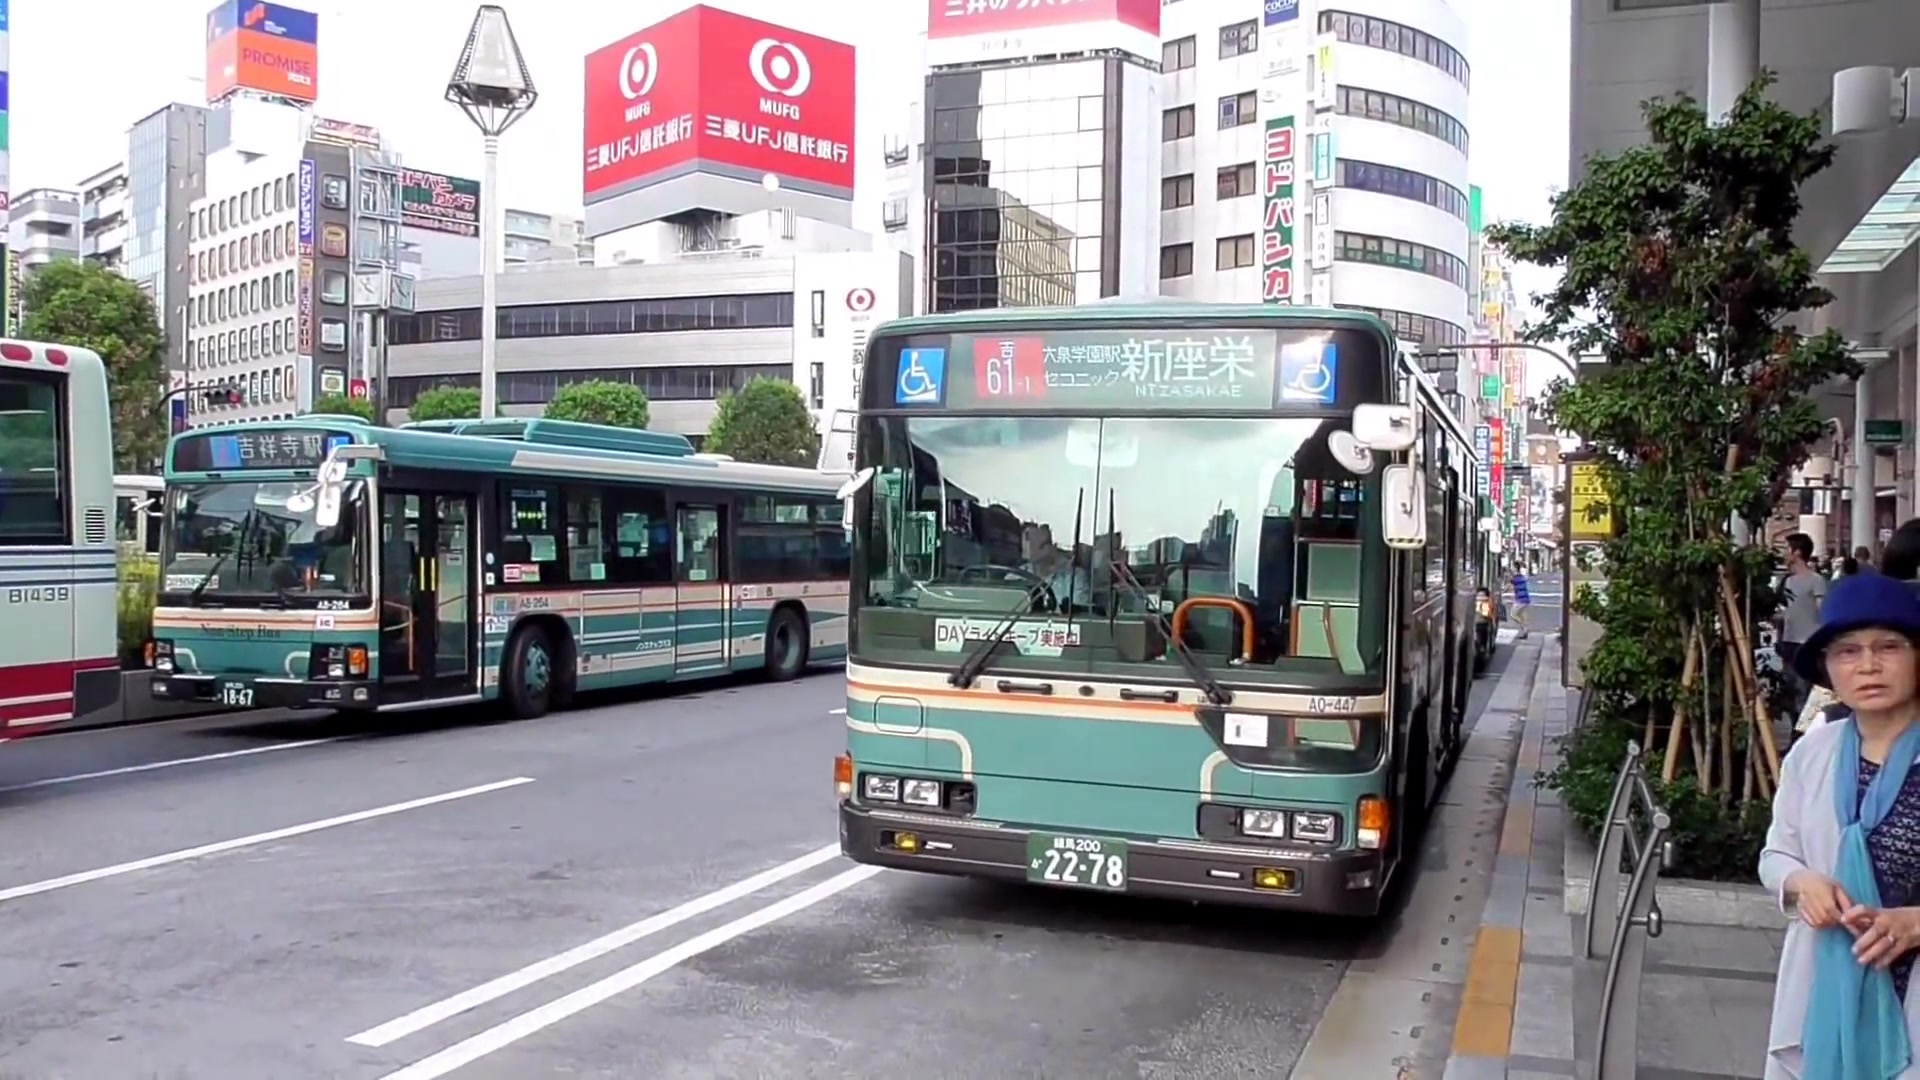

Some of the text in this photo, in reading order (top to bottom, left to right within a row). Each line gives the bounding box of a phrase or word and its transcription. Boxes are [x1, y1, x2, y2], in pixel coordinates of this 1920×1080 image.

[242, 48, 311, 75] PROMISE
[625, 101, 651, 122] MUFG
[759, 98, 800, 120] MUFG
[586, 114, 693, 172] 三菱UFJ信託銀行
[705, 115, 849, 164] 三菱UFJ信託銀行
[393, 169, 453, 192] ヨドバシ
[432, 190, 476, 211] カメラ
[1264, 127, 1294, 306] ヨドバシカ
[1042, 345, 1121, 364] 大泉学園駅
[1121, 336, 1256, 383] 新座栄
[1044, 369, 1120, 388] セコニック
[238, 434, 323, 460] 吉祥寺駅
[9, 587, 69, 604] B1439
[1044, 849, 1124, 888] 22-78
